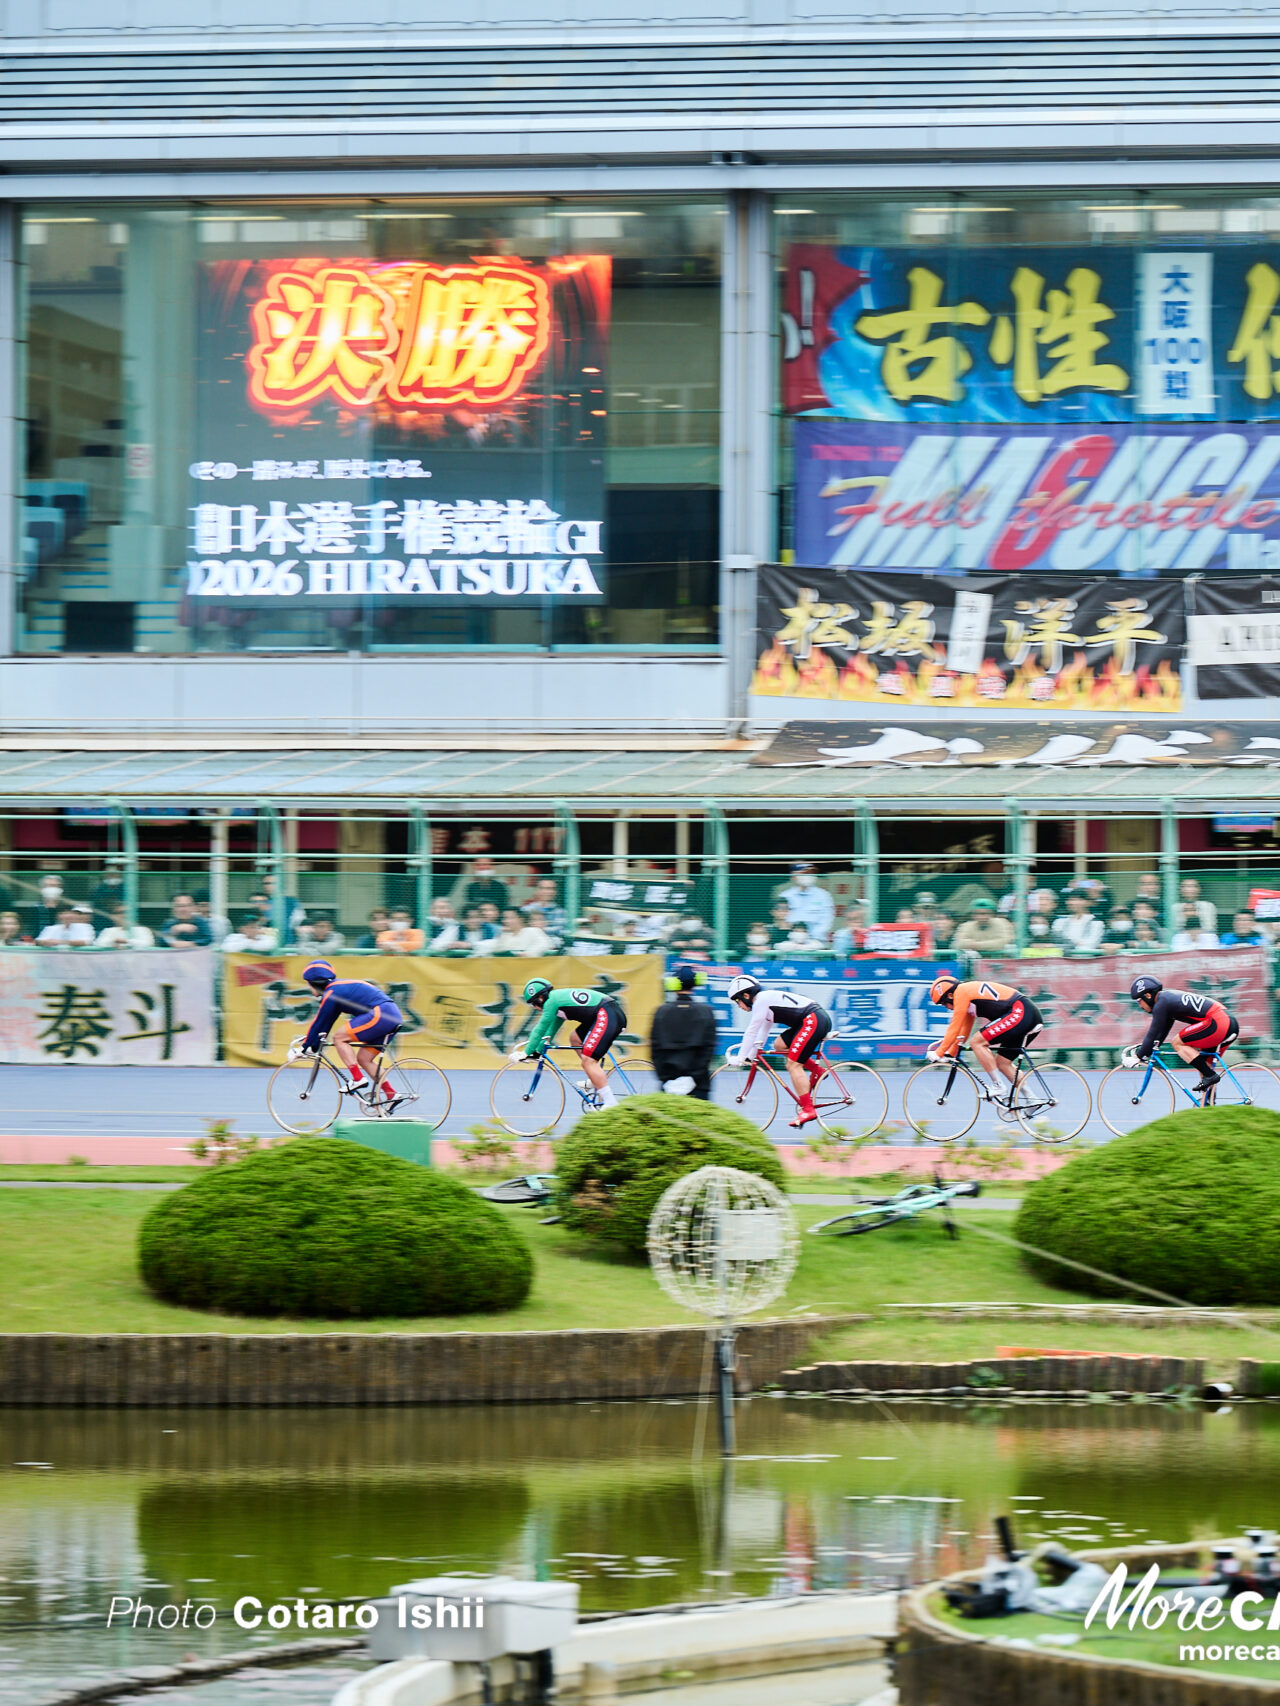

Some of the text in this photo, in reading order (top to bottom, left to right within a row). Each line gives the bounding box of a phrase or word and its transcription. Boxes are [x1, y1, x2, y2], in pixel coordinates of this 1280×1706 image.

[254, 267, 546, 402] 決勝
[856, 265, 1130, 403] 古性
[188, 558, 604, 596] 2026 HIRATSUKA
[776, 588, 946, 666] 松坂
[1001, 598, 1168, 675] 洋平
[572, 991, 590, 1006] 6
[782, 993, 799, 1006] 1
[979, 983, 1000, 1001] 7
[1136, 977, 1146, 993] 2
[1181, 992, 1205, 1012] 2
[36, 984, 191, 1060] 泰斗
